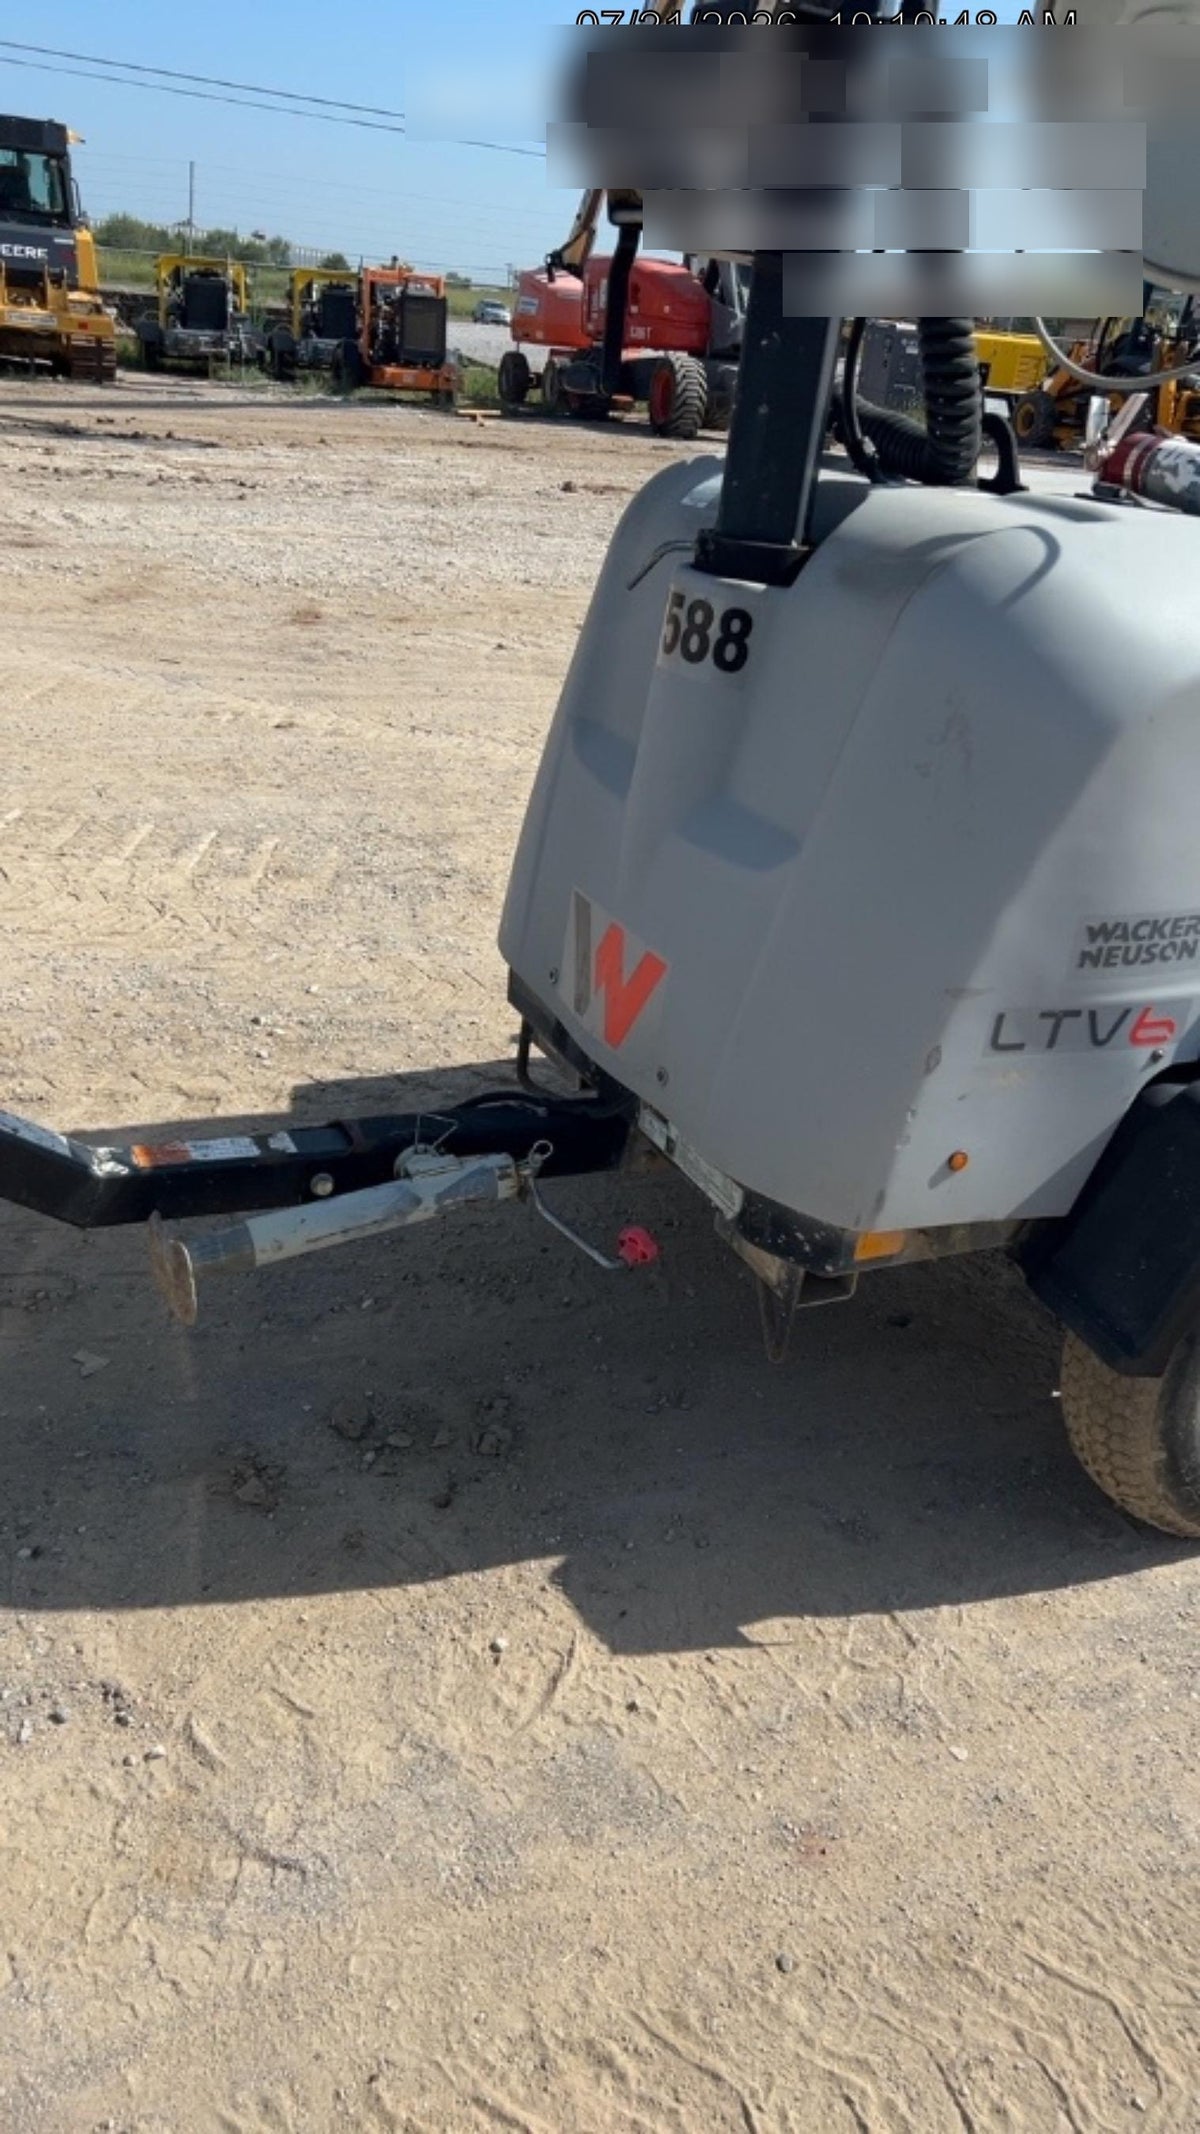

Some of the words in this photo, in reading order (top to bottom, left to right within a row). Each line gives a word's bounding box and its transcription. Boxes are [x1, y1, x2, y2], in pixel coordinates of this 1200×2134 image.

[0, 243, 48, 259] EERE
[663, 592, 753, 673] 588
[1086, 914, 1200, 944] WACKER
[1077, 939, 1199, 969] NEUSON
[990, 1006, 1176, 1051] LTV6
